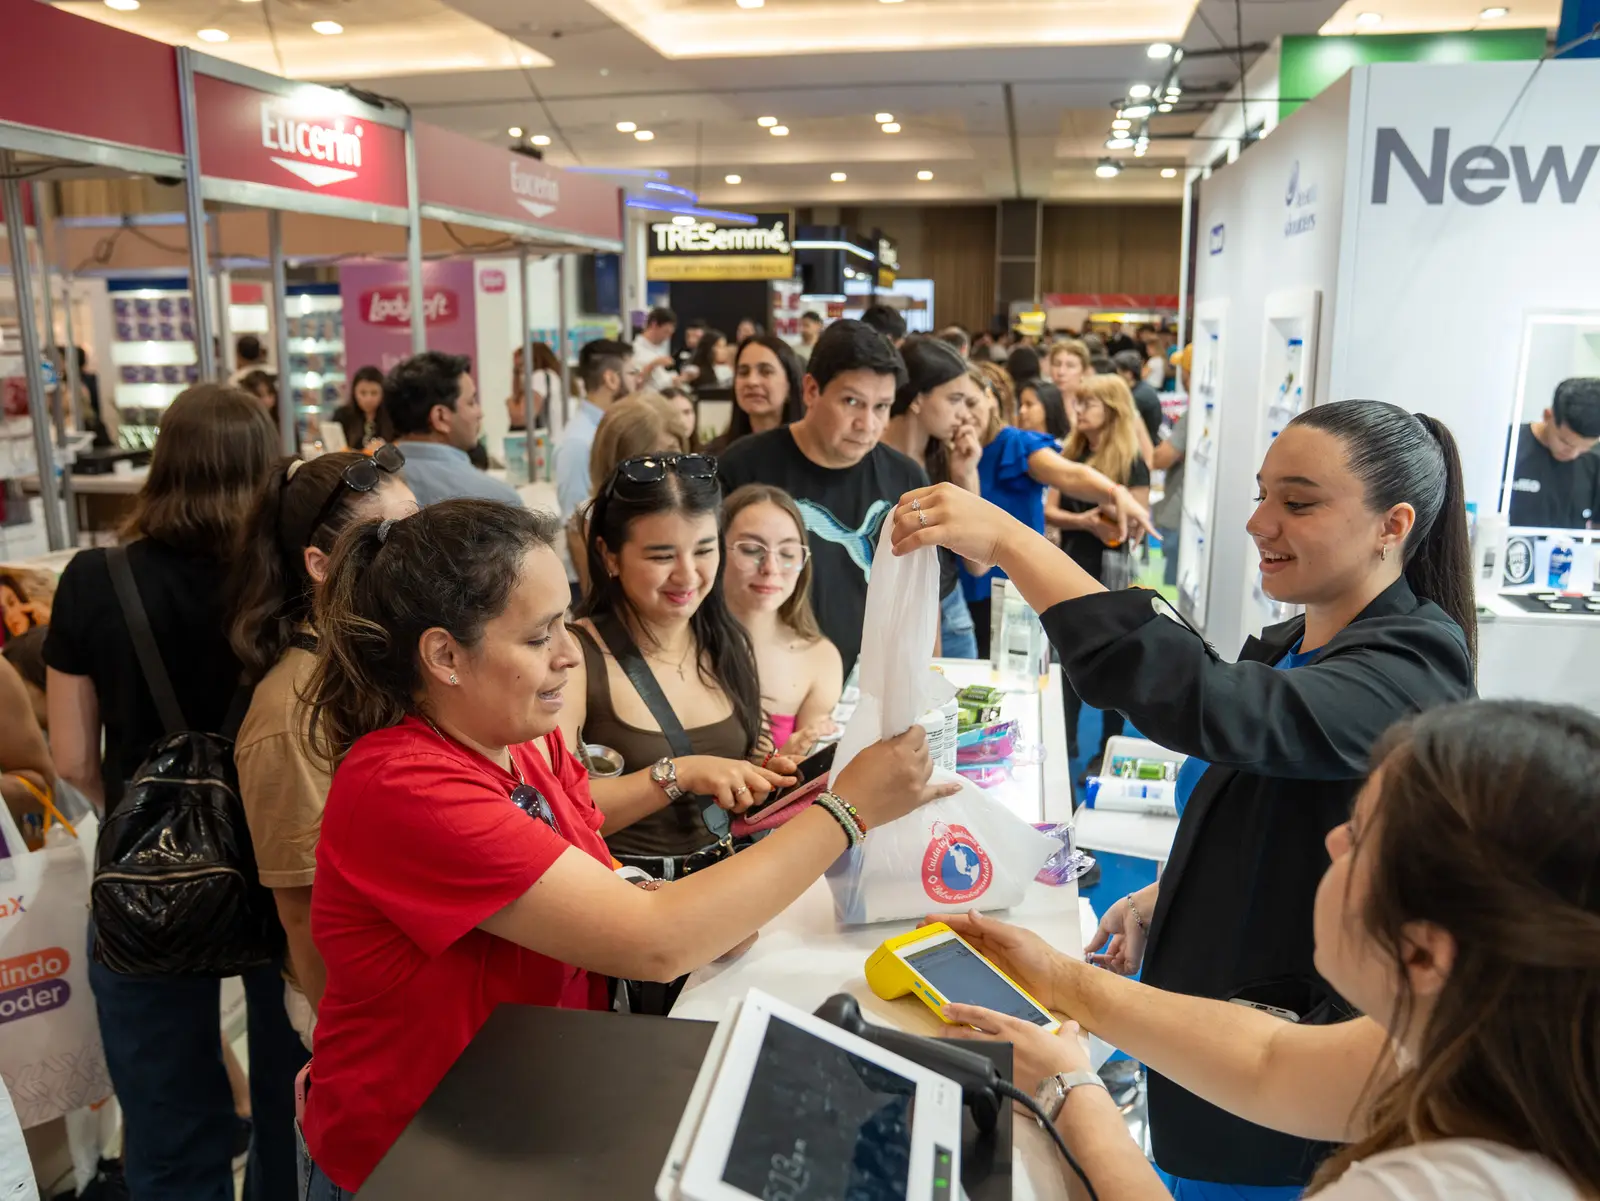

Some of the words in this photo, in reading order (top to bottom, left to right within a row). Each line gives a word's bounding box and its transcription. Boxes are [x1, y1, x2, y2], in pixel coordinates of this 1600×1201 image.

[261, 101, 362, 167] Eucerin
[1371, 127, 1600, 206] New
[368, 292, 450, 322] Ladyoft
[0, 955, 62, 987] indo
[0, 986, 62, 1017] oder
